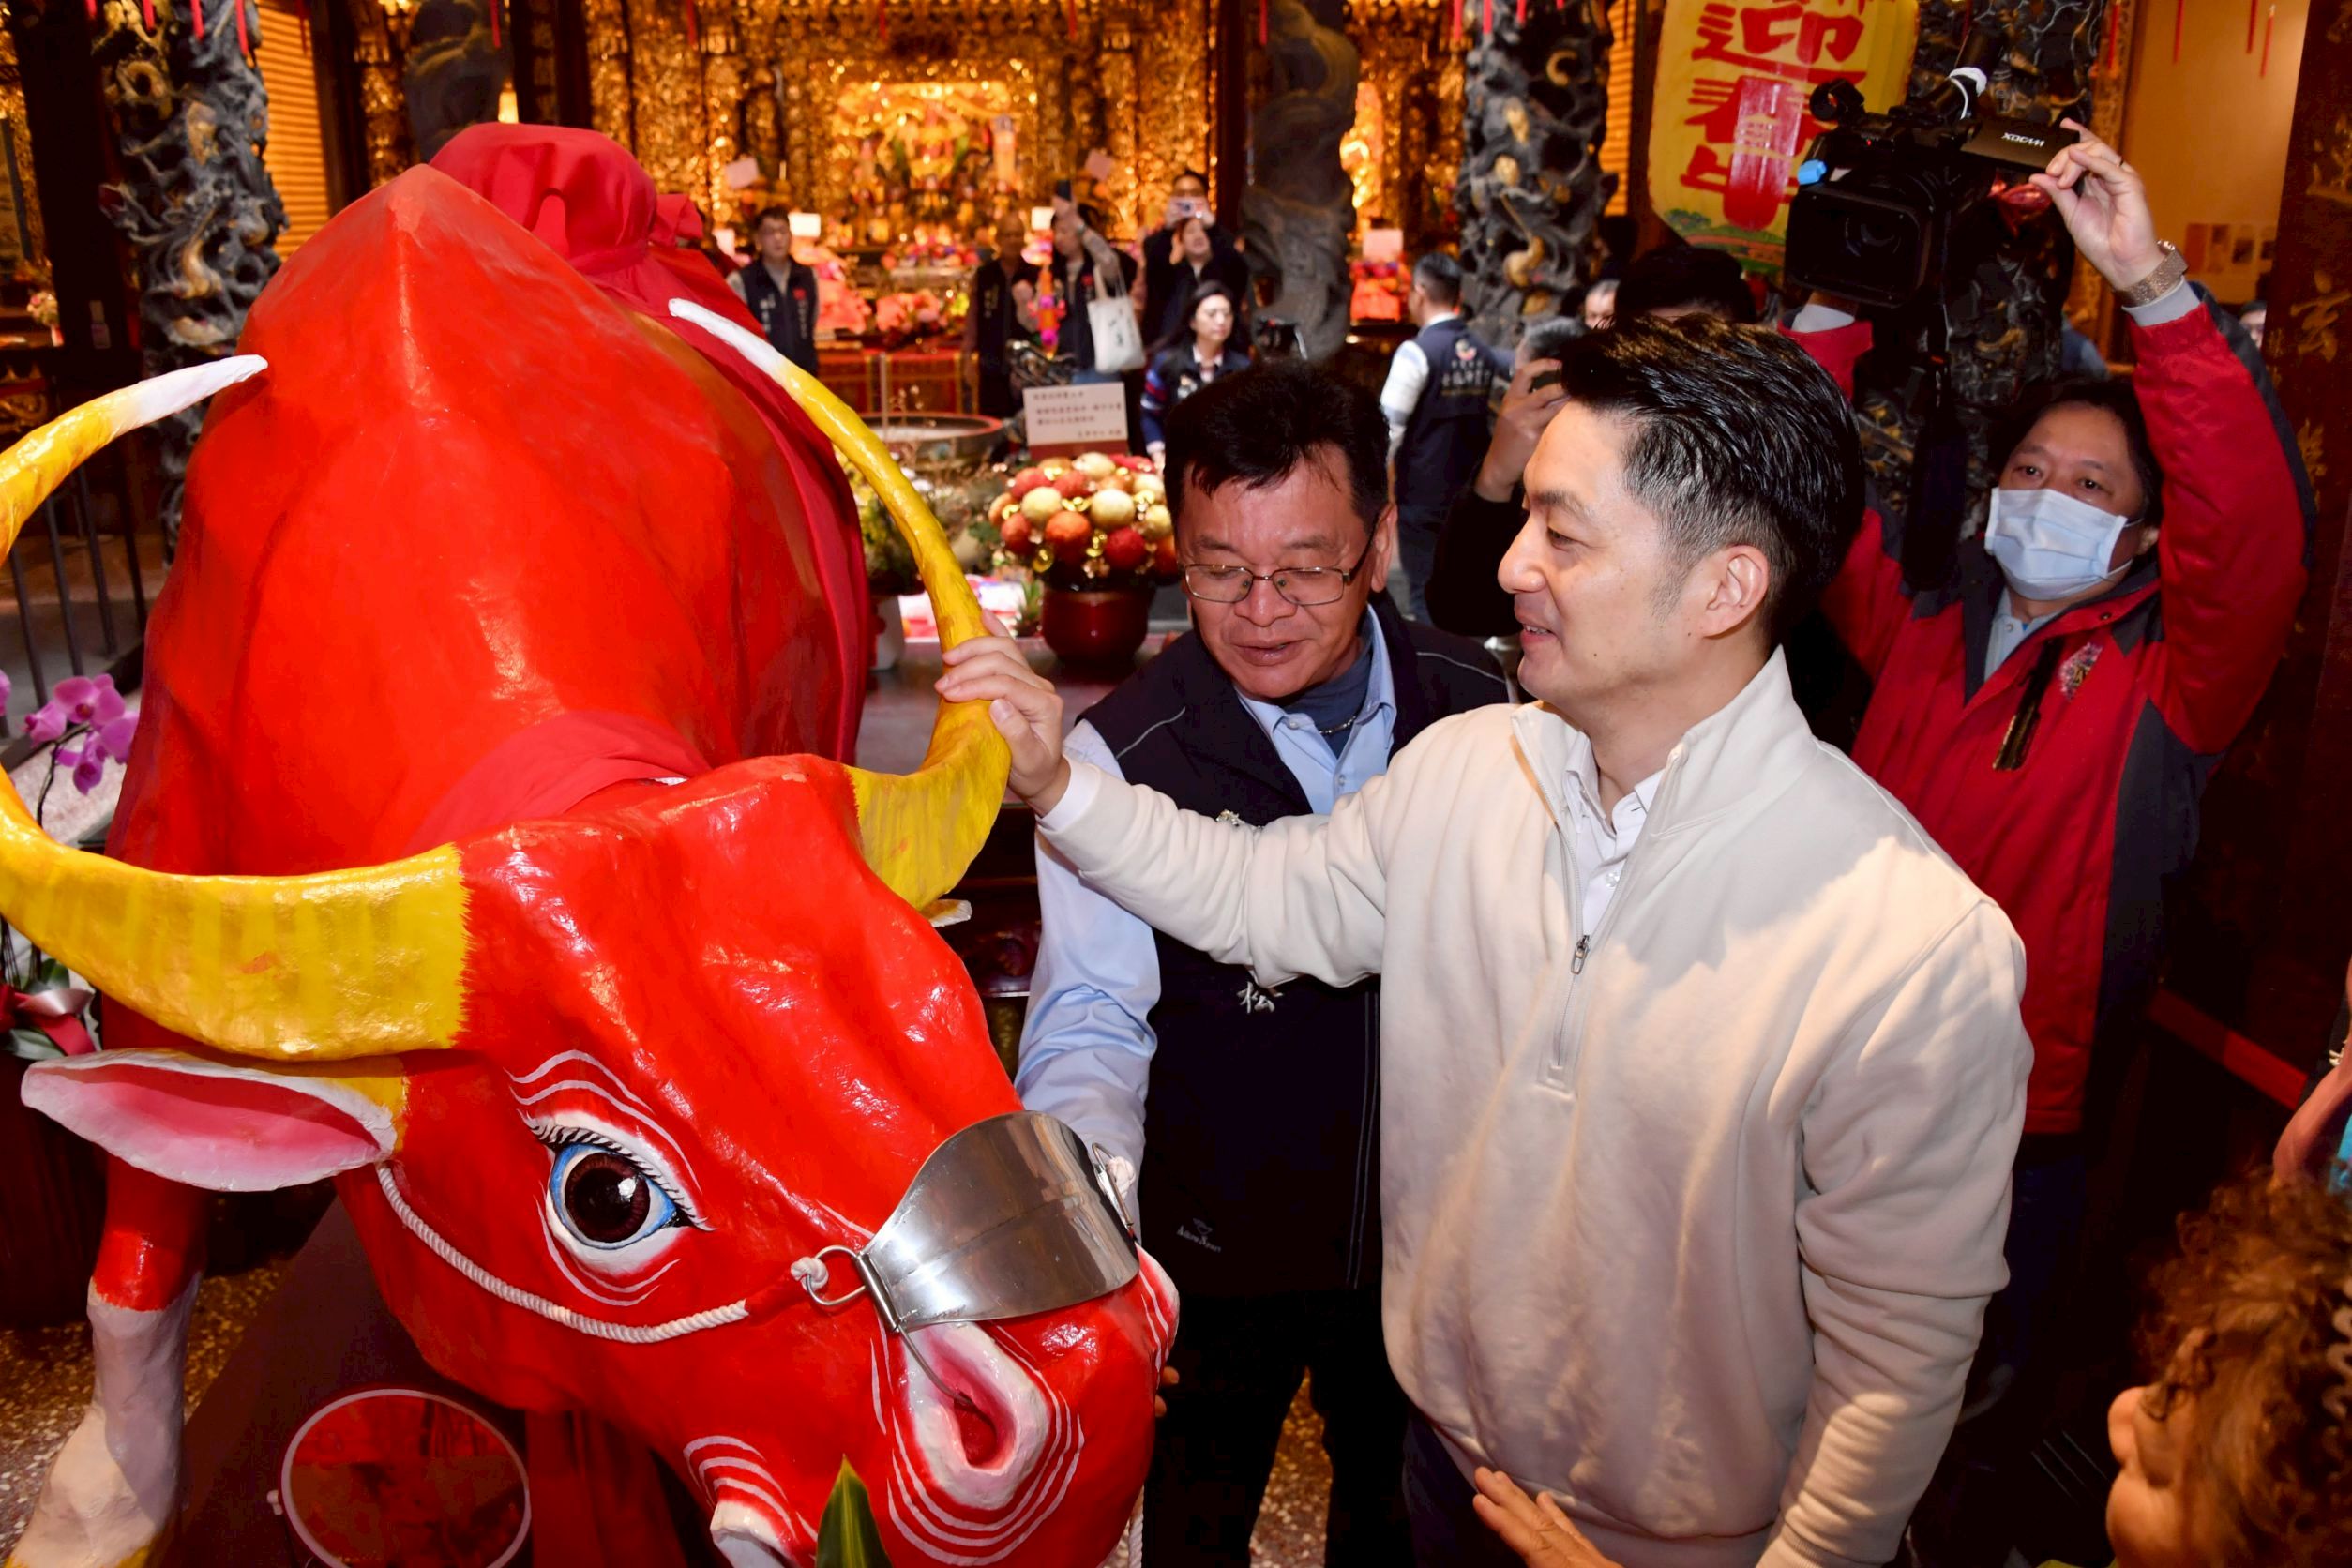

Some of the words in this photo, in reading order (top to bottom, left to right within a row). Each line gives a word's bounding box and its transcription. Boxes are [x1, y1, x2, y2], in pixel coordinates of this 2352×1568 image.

[1680, 0, 1868, 233] 迎春牛
[2001, 131, 2045, 148] XDCAM
